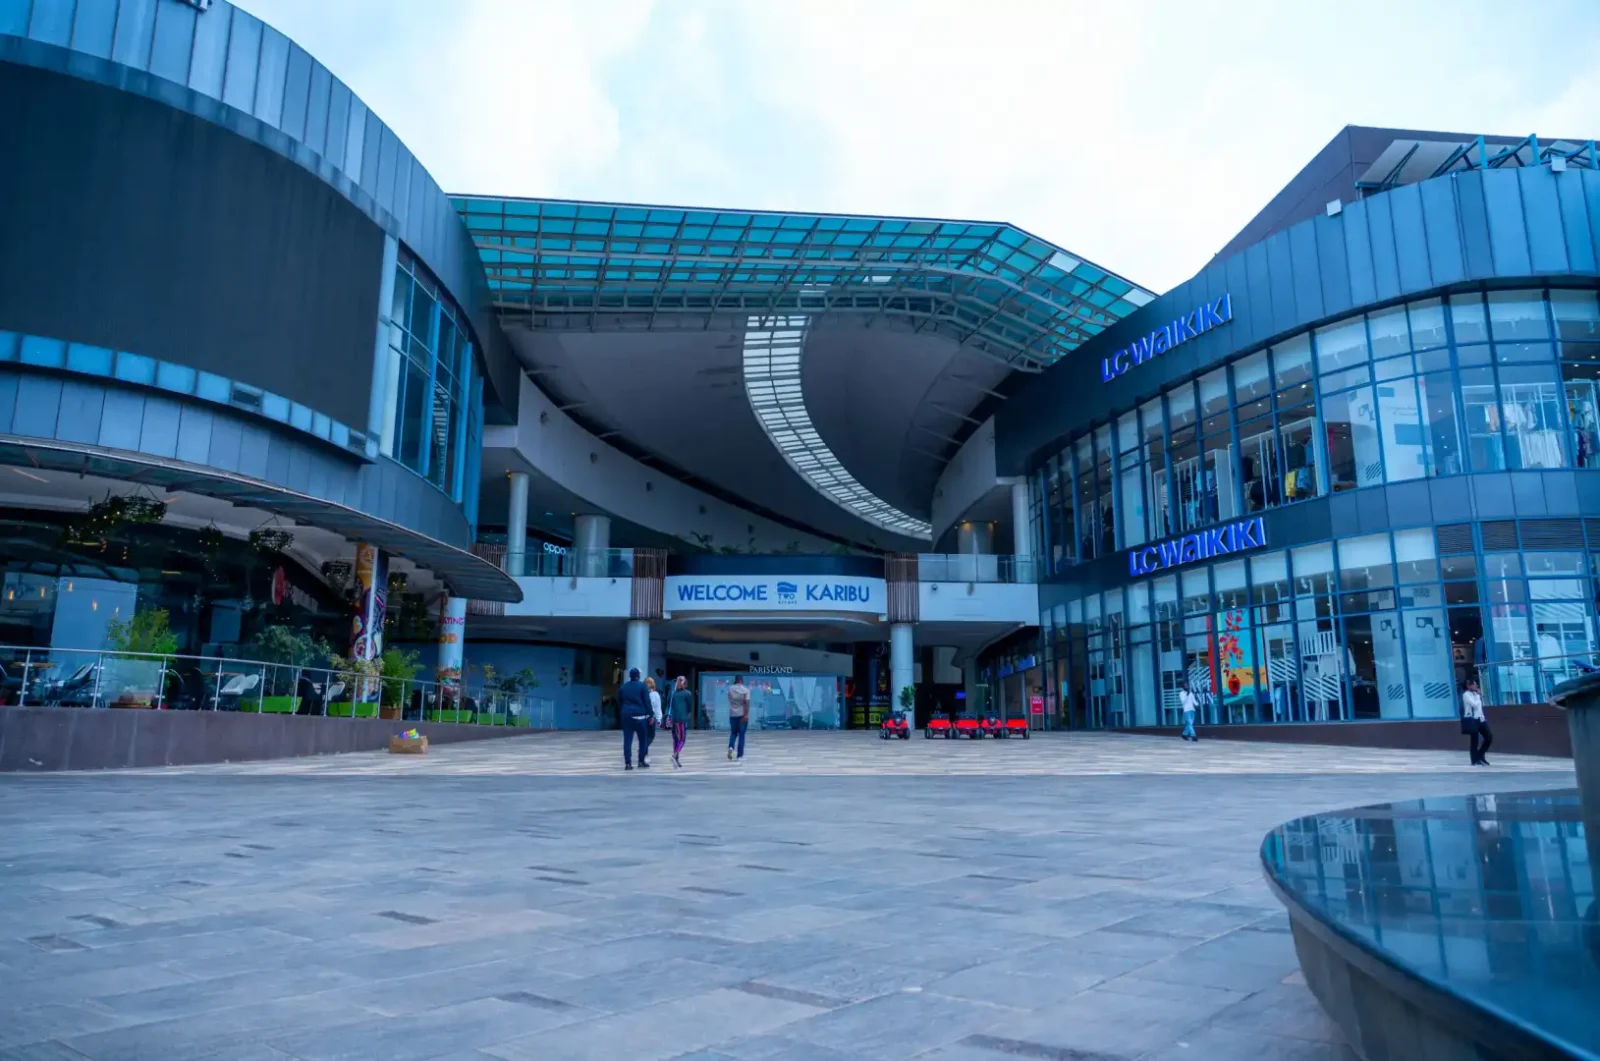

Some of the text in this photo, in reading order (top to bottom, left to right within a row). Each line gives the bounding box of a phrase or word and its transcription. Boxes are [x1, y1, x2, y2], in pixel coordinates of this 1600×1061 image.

[1101, 350, 1129, 383] LC
[1129, 547, 1157, 576] LC
[678, 584, 869, 602] WELCOME KARIBU
